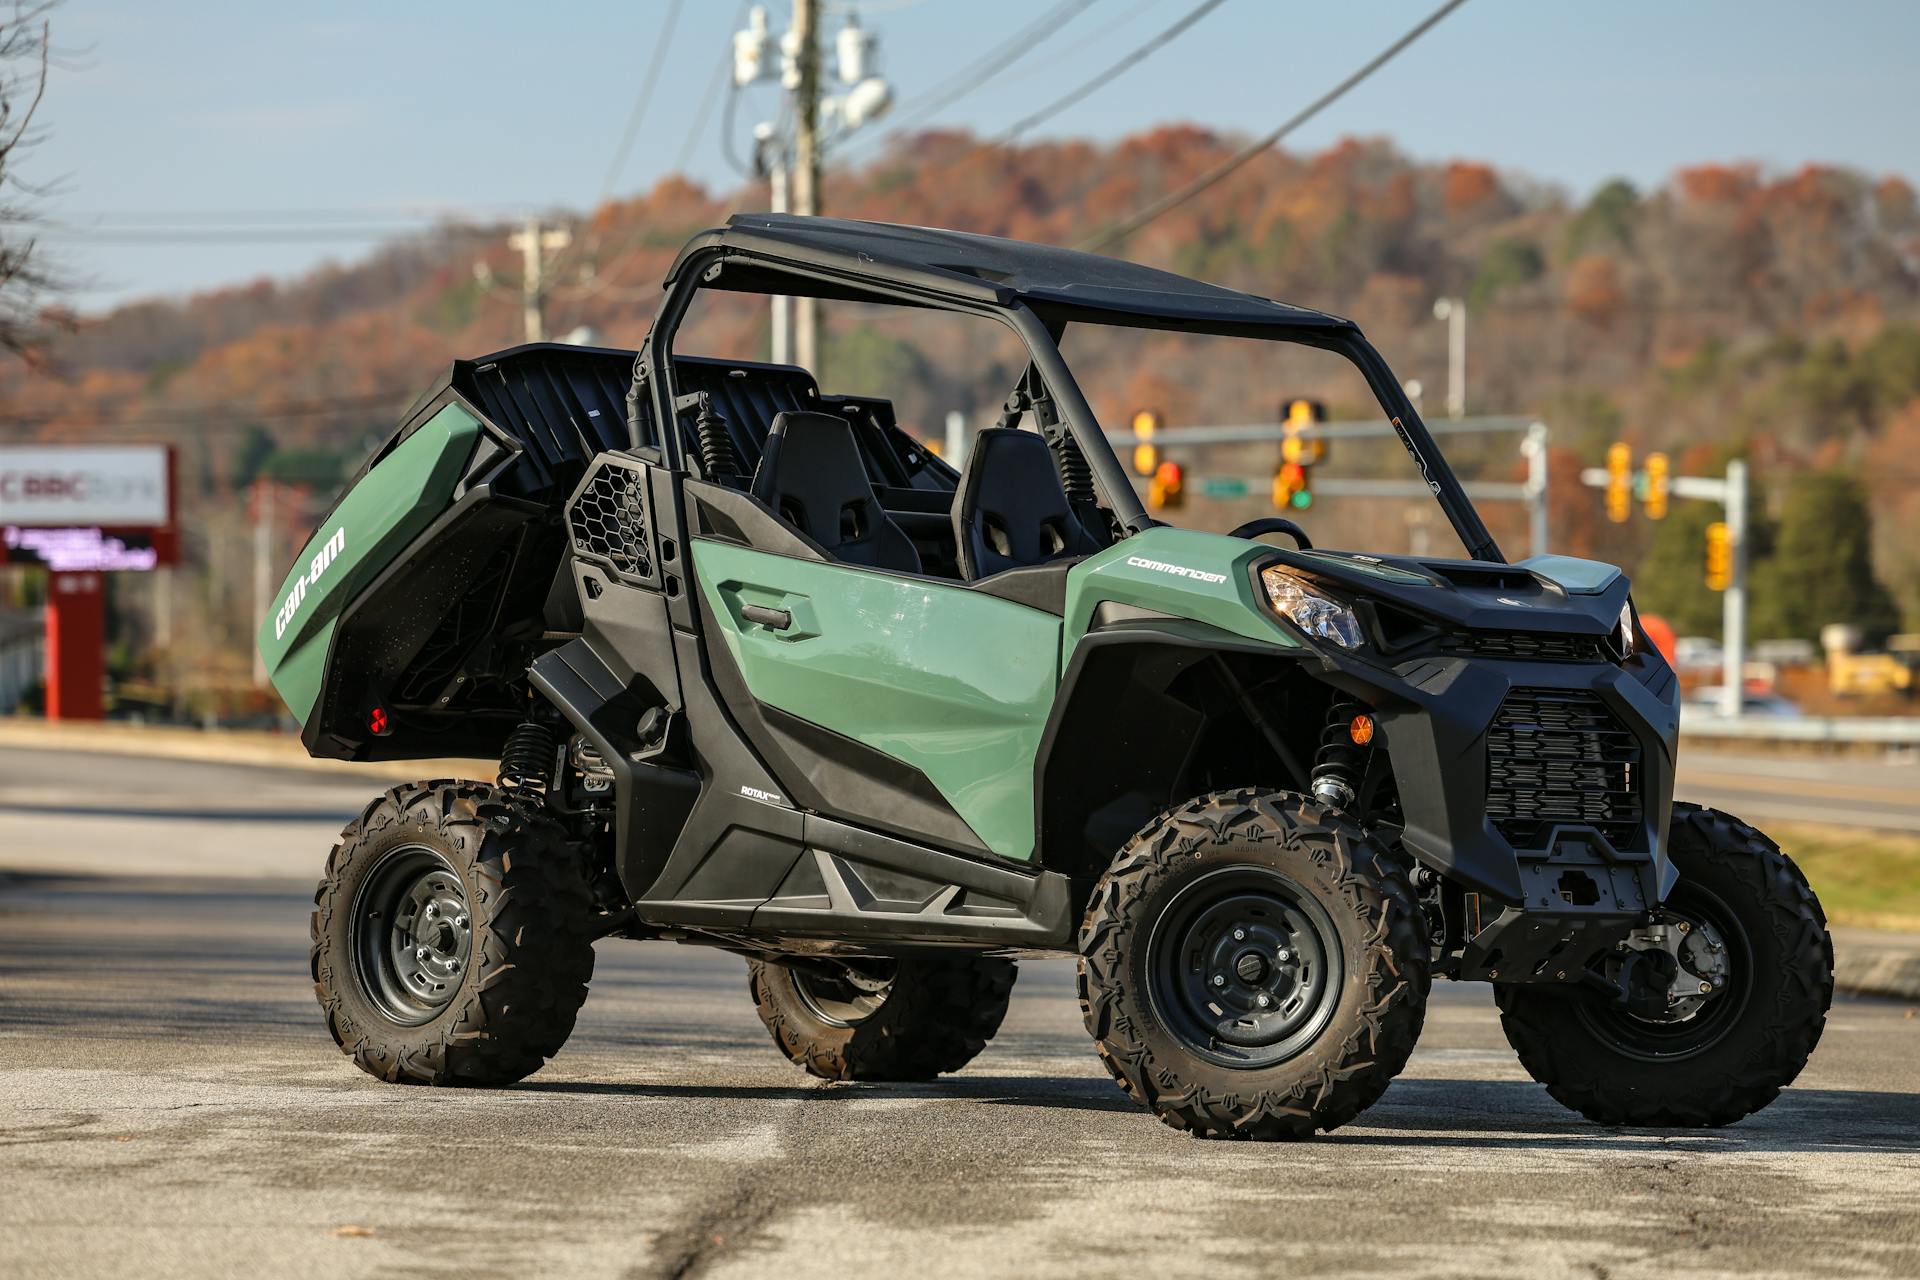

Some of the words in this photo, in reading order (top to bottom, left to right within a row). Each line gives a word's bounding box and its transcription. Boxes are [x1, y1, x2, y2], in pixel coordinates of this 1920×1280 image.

[275, 526, 345, 640] can-am
[1127, 556, 1227, 584] COMMANDER
[741, 785, 769, 801] ROTAX
